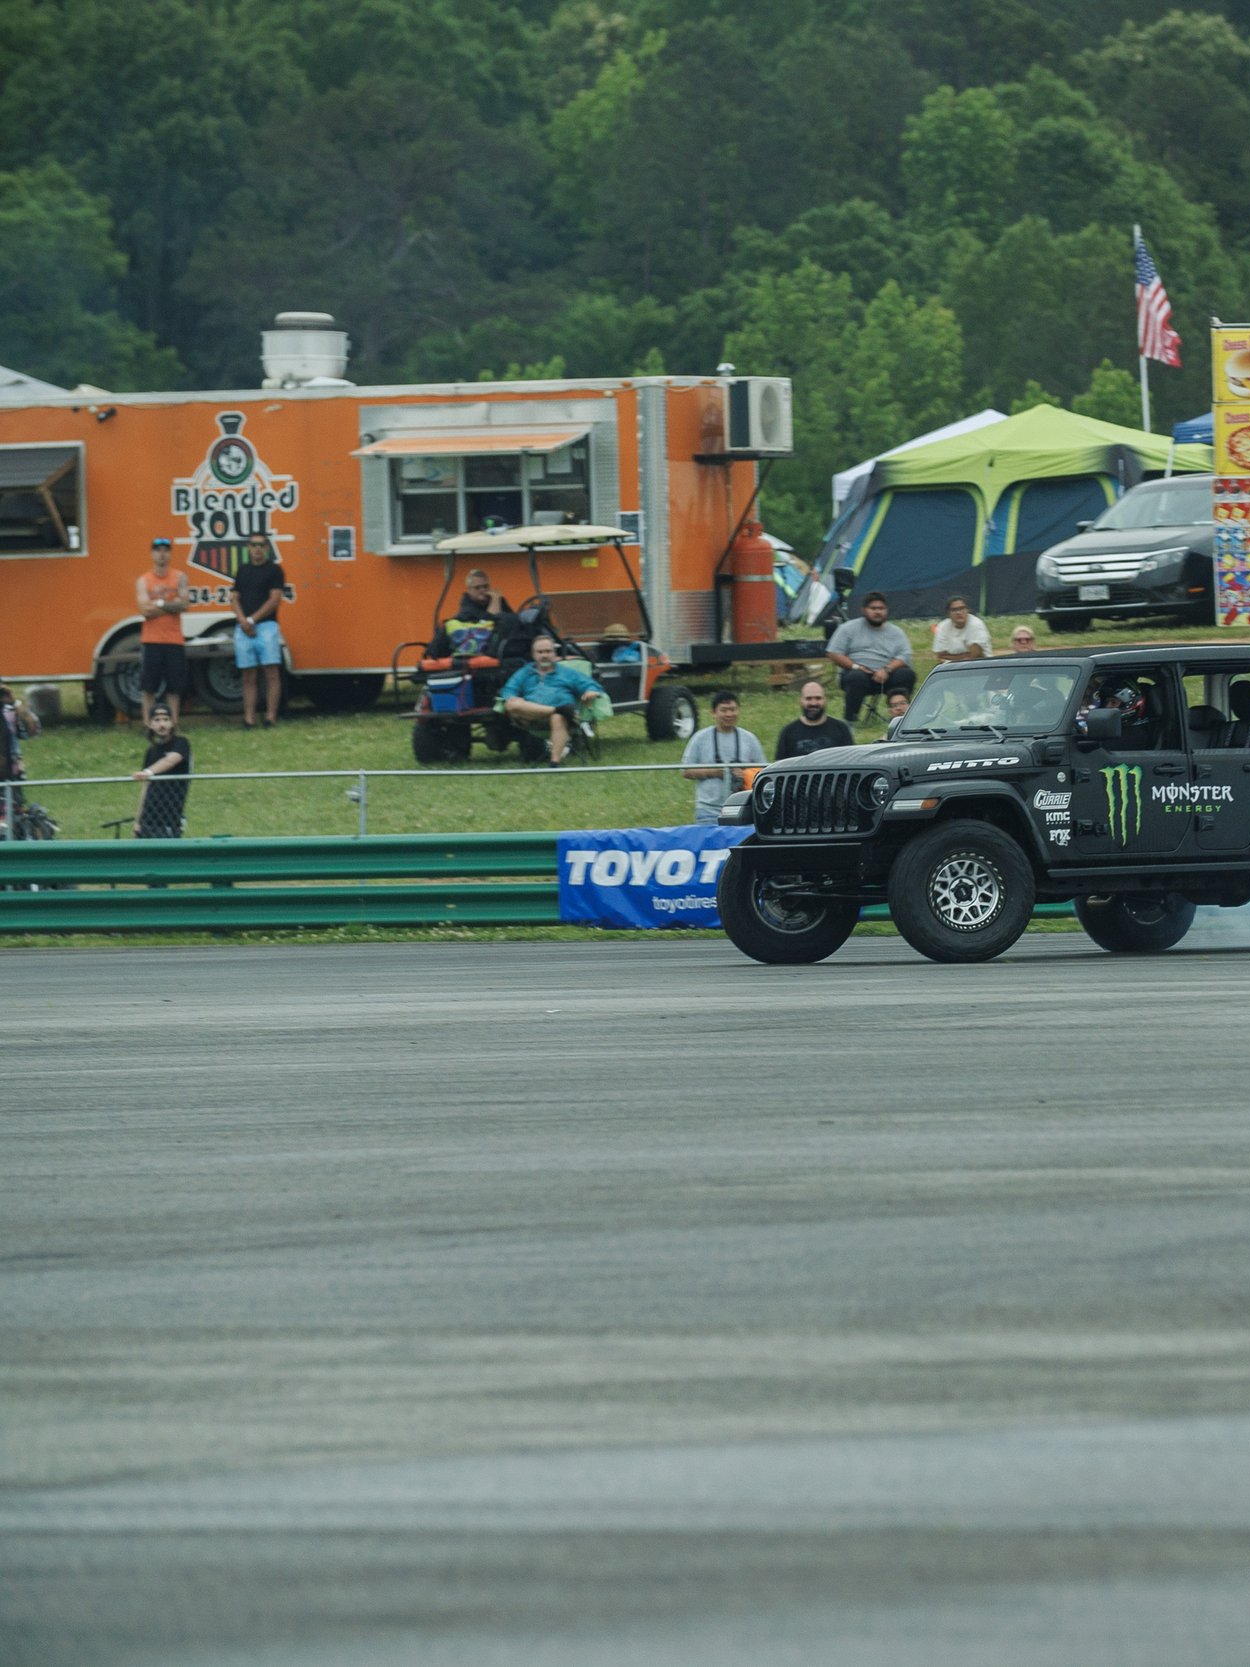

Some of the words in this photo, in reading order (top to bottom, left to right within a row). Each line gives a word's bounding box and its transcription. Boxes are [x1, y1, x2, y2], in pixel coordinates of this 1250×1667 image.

[175, 484, 295, 511] Blended
[926, 756, 1020, 772] NITTO
[1034, 790, 1071, 809] CURRIE
[1151, 782, 1234, 804] MONSTER
[1045, 811, 1071, 822] KMC
[1165, 804, 1222, 813] ENERGY
[1049, 828, 1071, 846] FOX
